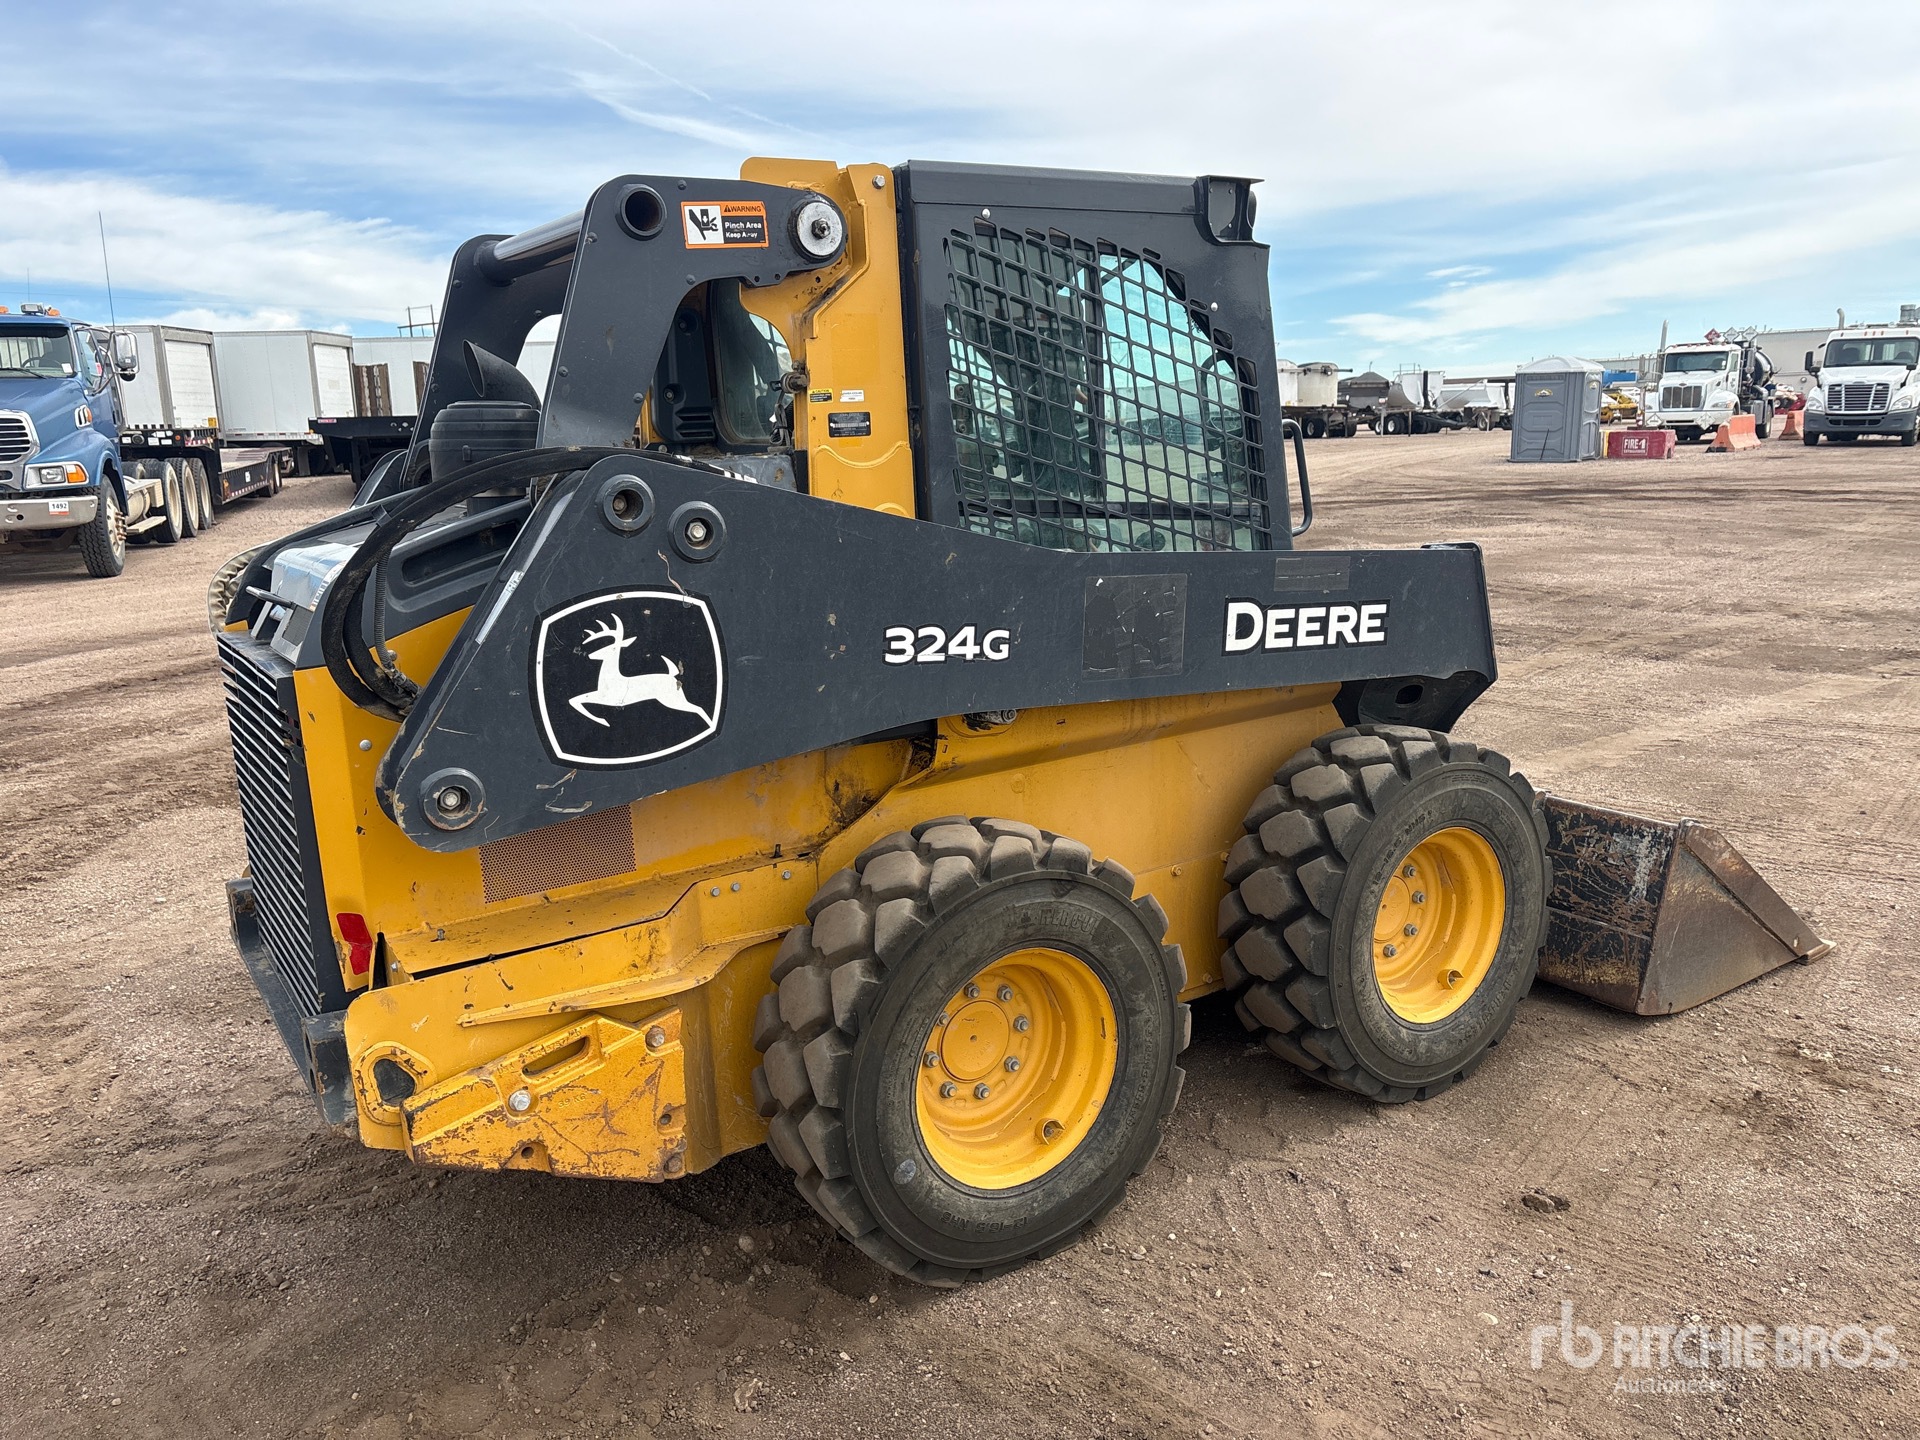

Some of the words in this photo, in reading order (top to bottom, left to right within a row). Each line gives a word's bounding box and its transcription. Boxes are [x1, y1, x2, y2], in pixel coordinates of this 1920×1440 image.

[724, 221, 745, 229] Pinch
[745, 221, 762, 229] Area
[725, 231, 741, 239] Keep
[1624, 438, 1639, 449] FIRE
[1225, 602, 1388, 652] DEERE
[884, 626, 1011, 664] 324G
